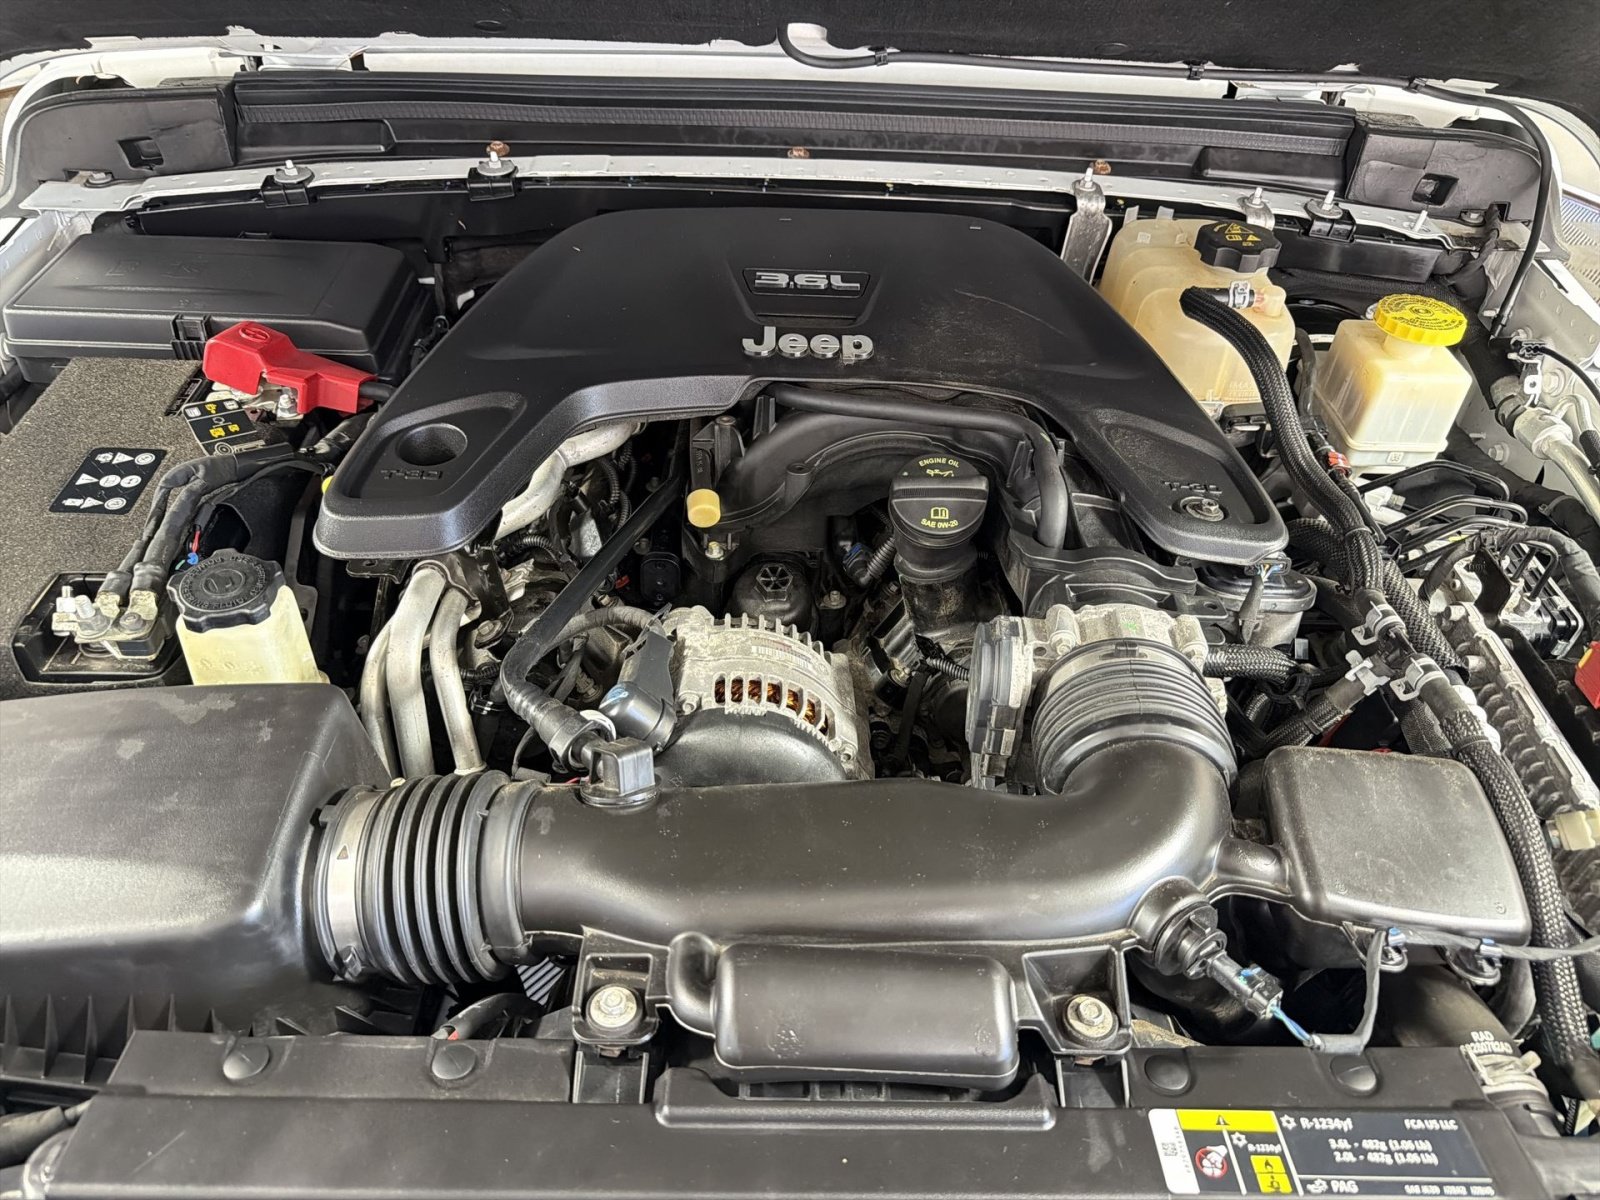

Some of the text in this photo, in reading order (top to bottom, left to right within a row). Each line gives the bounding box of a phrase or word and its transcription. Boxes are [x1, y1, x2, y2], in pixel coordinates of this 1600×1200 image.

[755, 271, 860, 291] 3.6L
[742, 326, 875, 363] Jeep
[919, 458, 960, 468] ENGINE OIL
[921, 519, 959, 528] SAE 0W-20
[1471, 1031, 1495, 1041] RAD
[1330, 1180, 1359, 1193] PAG
